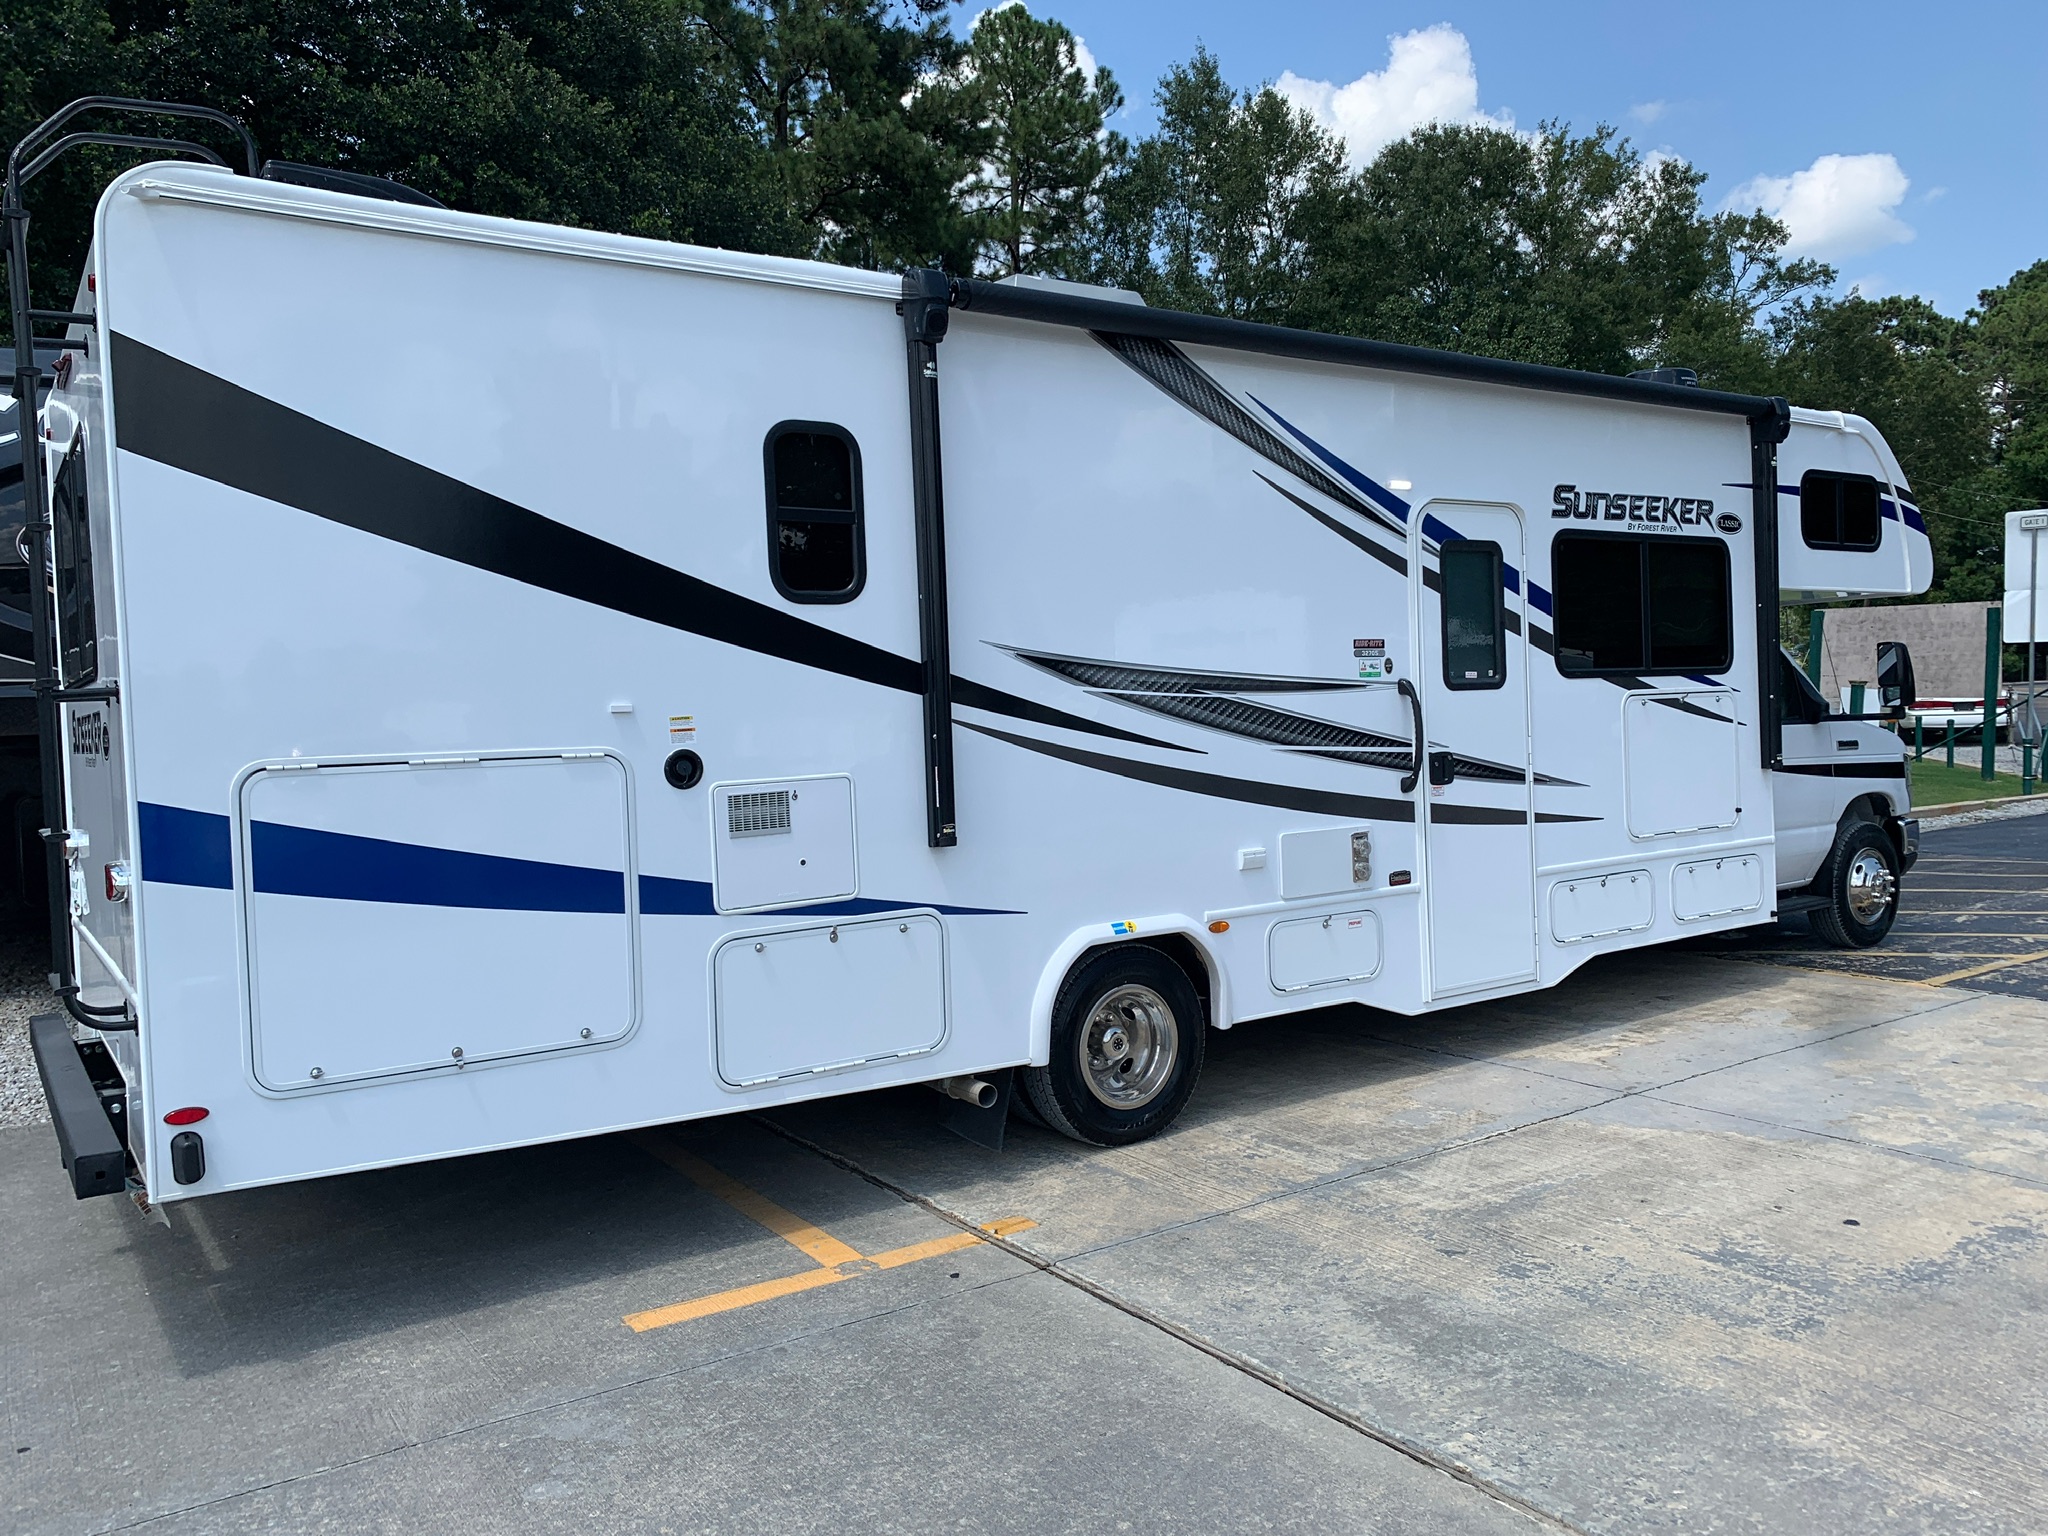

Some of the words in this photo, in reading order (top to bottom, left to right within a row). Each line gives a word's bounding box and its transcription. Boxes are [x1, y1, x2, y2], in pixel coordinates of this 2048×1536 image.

[1551, 484, 1716, 534] SUNSEEKER
[1717, 519, 1741, 529] CLASSIC
[2025, 518, 2040, 526] GATE
[1638, 523, 1660, 532] FOREST
[1661, 524, 1678, 532] RIVER
